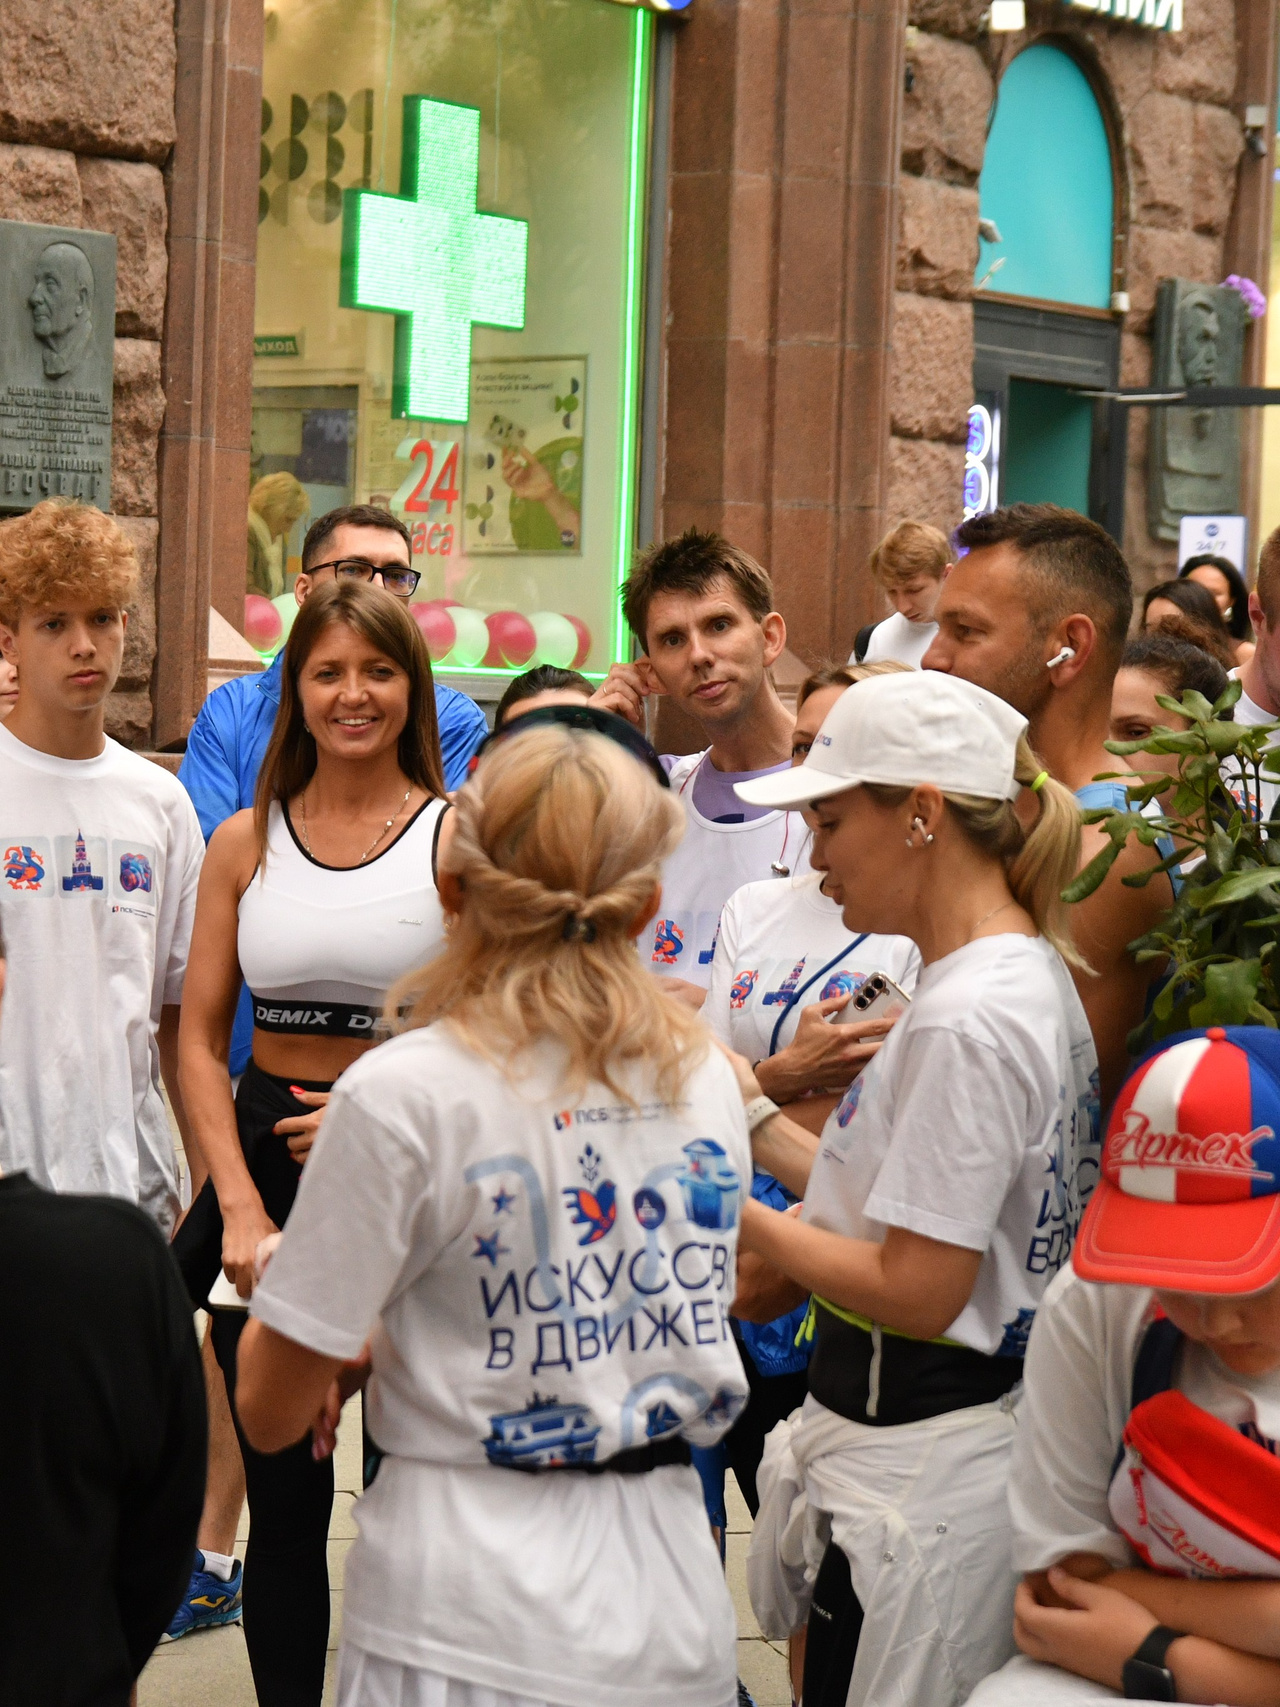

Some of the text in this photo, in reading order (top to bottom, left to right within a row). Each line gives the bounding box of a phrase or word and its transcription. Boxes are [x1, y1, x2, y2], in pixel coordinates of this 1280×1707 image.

[255, 340, 296, 353] ЫХОД
[4, 469, 101, 500] БОЧВАР
[401, 438, 460, 514] 24
[411, 522, 454, 556] аса
[255, 1005, 333, 1025] DEMIX
[348, 1013, 395, 1030] DE
[575, 1107, 609, 1124] ПСБ
[484, 1327, 515, 1370] В
